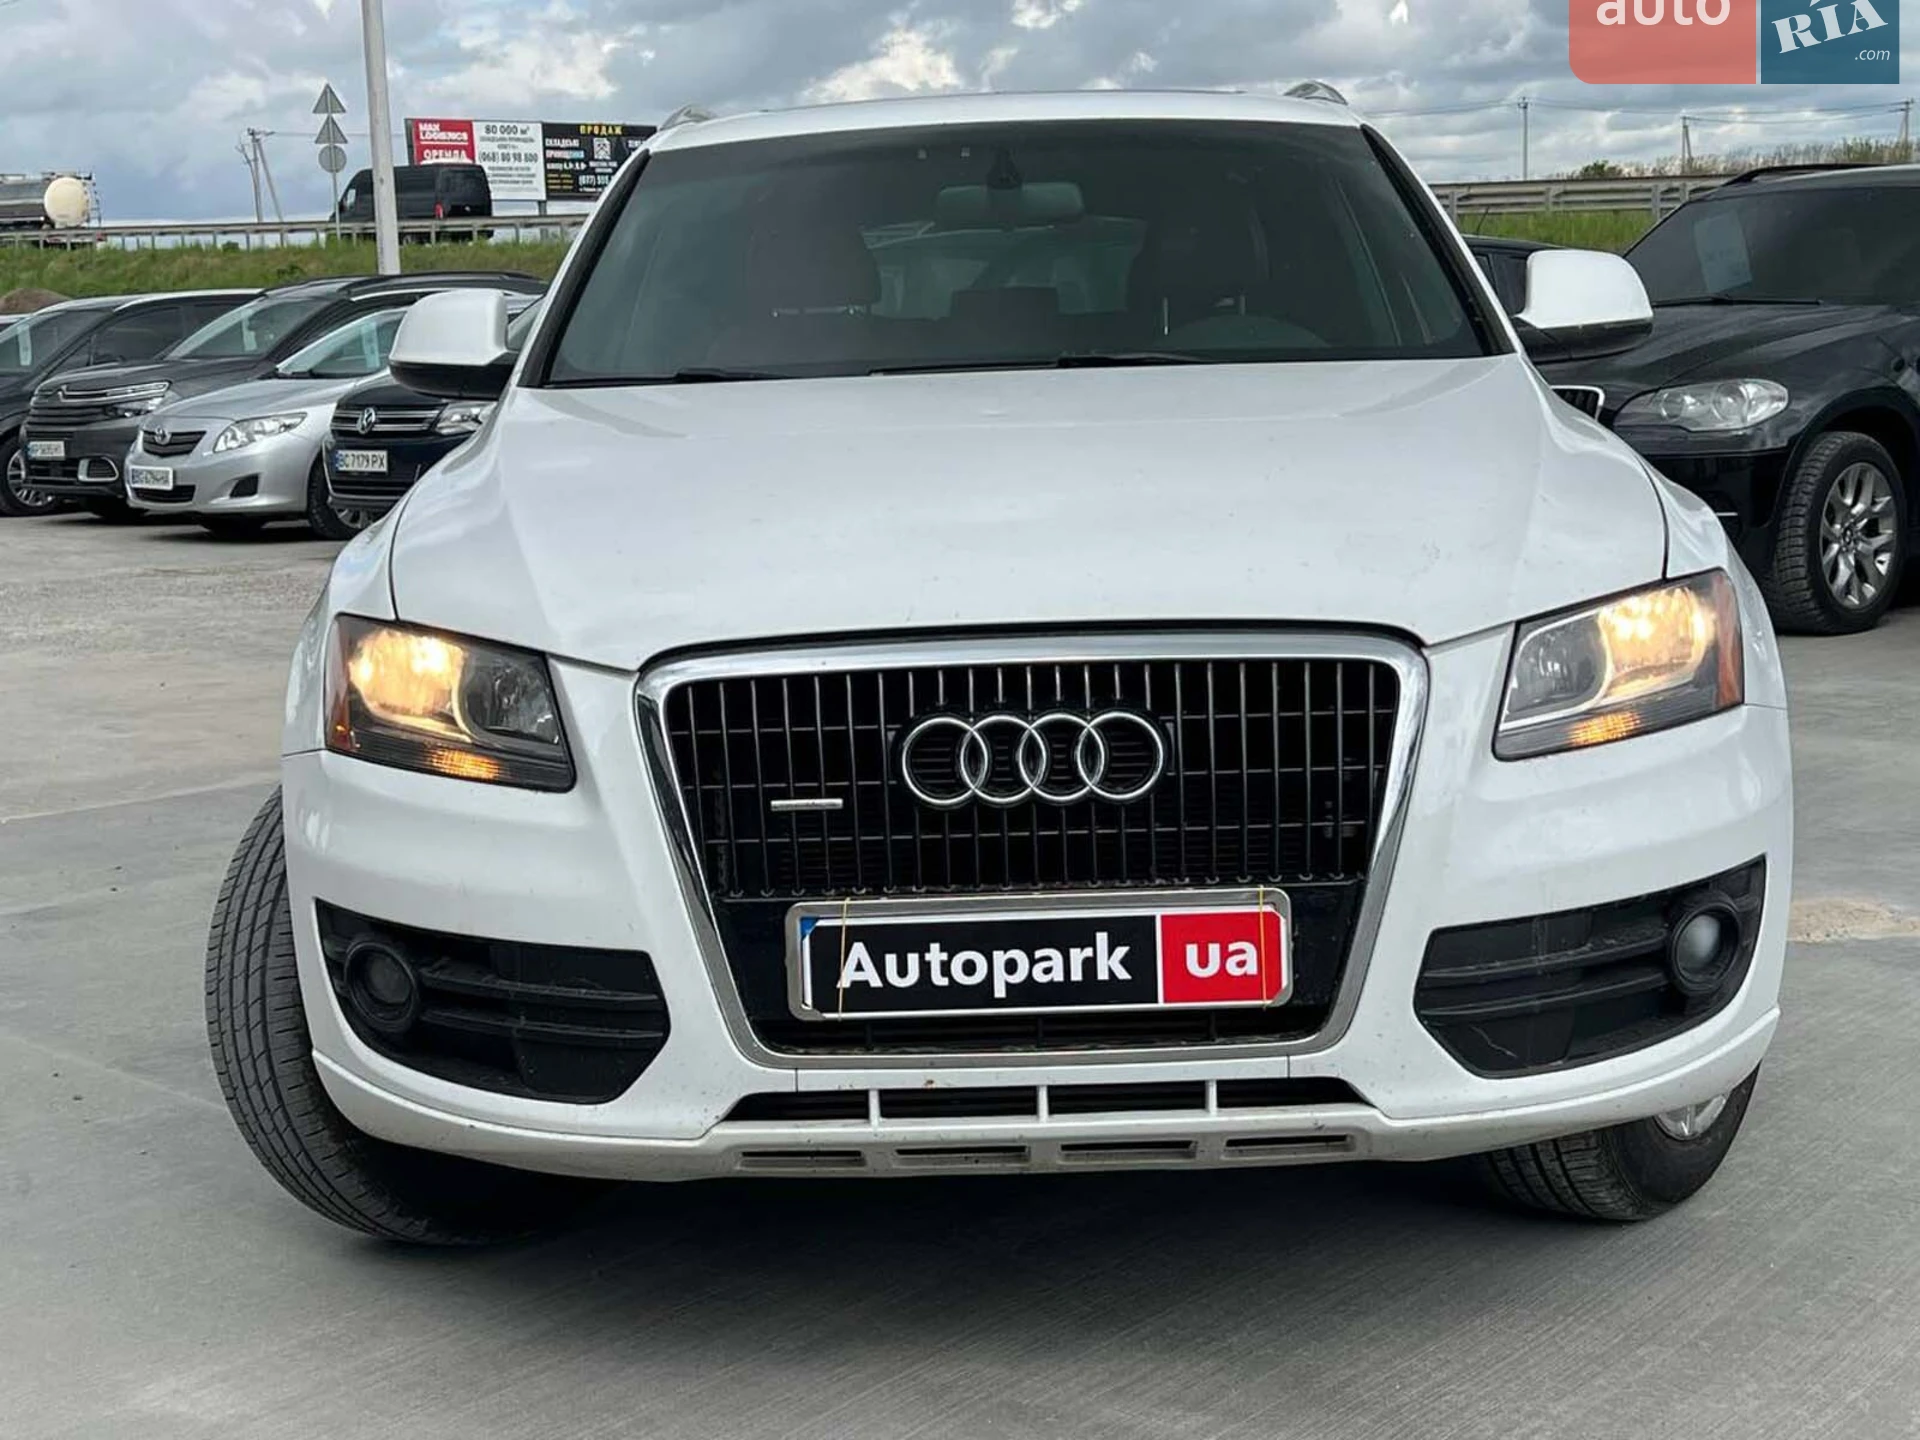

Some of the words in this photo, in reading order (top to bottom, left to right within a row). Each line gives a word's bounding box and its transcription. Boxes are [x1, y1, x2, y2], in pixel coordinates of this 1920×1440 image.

[484, 124, 497, 135] 80
[499, 124, 518, 135] 000
[579, 125, 622, 135] ПРОДАЖ
[836, 931, 1132, 998] Autopark
[1185, 941, 1259, 976] ua
